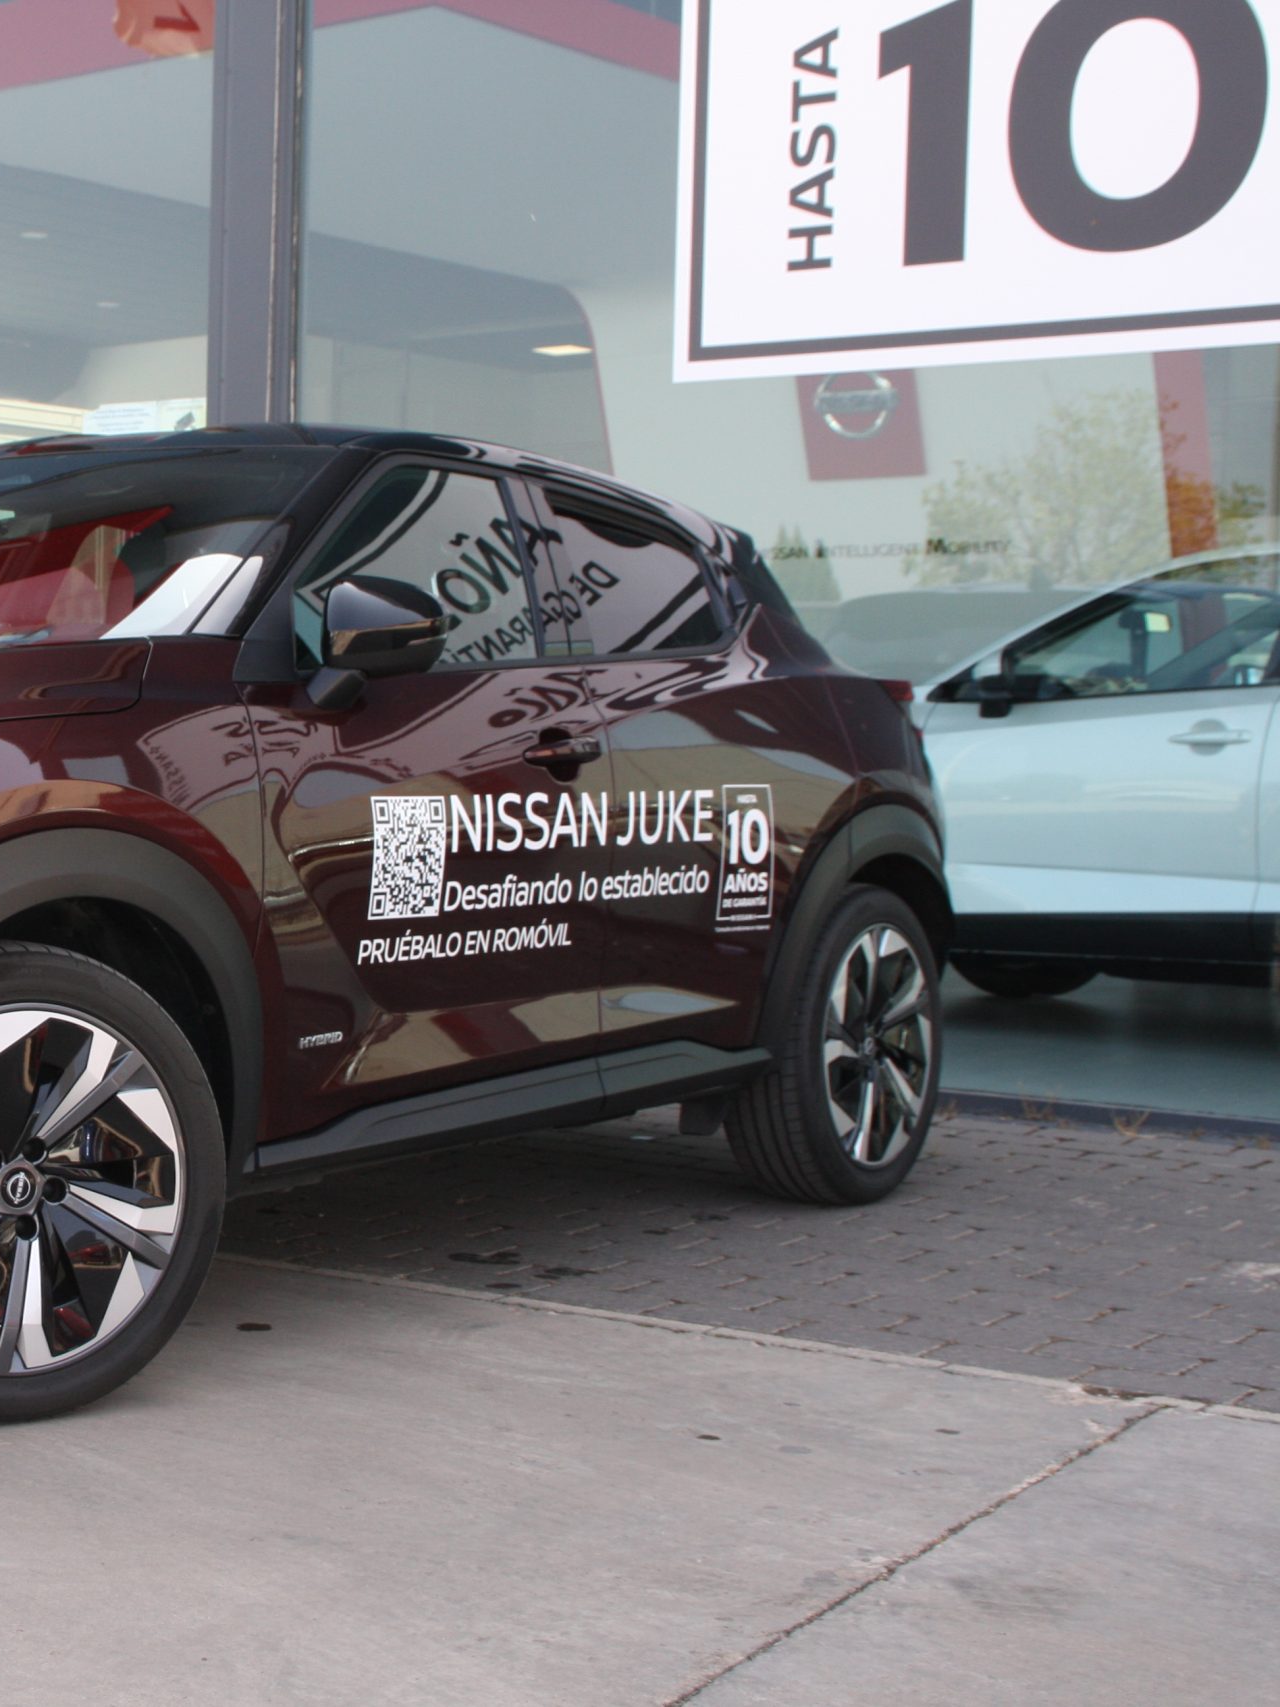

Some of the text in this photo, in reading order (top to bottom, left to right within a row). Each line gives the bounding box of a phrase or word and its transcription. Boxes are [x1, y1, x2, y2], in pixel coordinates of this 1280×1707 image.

[787, 27, 839, 272] HASTA
[878, 0, 1270, 266] 10
[450, 789, 713, 853] NISSAN JUKE
[727, 808, 769, 865] 10
[443, 864, 710, 912] Desafiando lo establecido
[723, 867, 769, 894] AÑOS
[357, 918, 572, 965] PRUÉBALO EN ROMÓVIL
